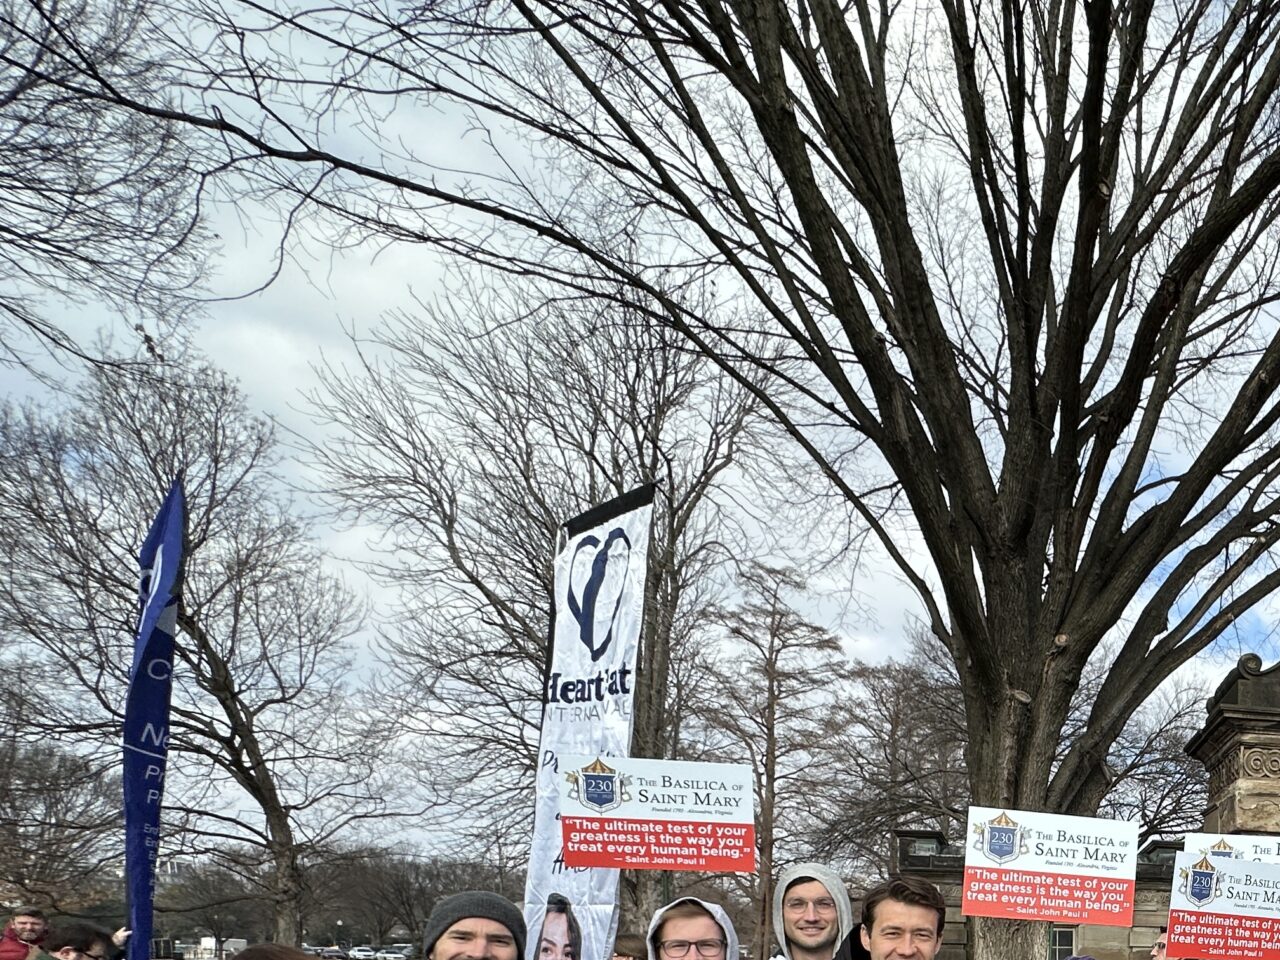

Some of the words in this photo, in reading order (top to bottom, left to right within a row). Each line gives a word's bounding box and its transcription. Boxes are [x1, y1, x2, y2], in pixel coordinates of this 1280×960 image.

[587, 779, 612, 792] 230
[636, 777, 657, 787] THE
[661, 775, 727, 791] BASILICA
[731, 784, 744, 792] OF
[638, 789, 688, 805] SAINT
[693, 792, 741, 807] MARY
[570, 832, 641, 843] greatness
[644, 832, 656, 844] is
[659, 833, 683, 844] the
[686, 836, 714, 848] way
[718, 837, 743, 849] you
[991, 831, 1014, 844] 230
[1035, 830, 1053, 841] THE
[1057, 829, 1115, 847] BASILICA
[1118, 840, 1130, 848] OF
[1034, 842, 1079, 859] SAINT
[1083, 846, 1127, 863] MARY
[1252, 844, 1272, 855] THE
[1193, 875, 1211, 888] 230
[1228, 875, 1242, 885] THE
[970, 881, 1032, 894] greatness
[1035, 884, 1046, 895] is
[1049, 886, 1070, 897] the
[1073, 889, 1098, 901] way
[1101, 892, 1124, 903] you
[1226, 886, 1260, 902] SAINT
[1174, 924, 1222, 936] greatness
[1224, 926, 1233, 937] is
[1235, 927, 1251, 938] the
[1253, 930, 1272, 942] way
